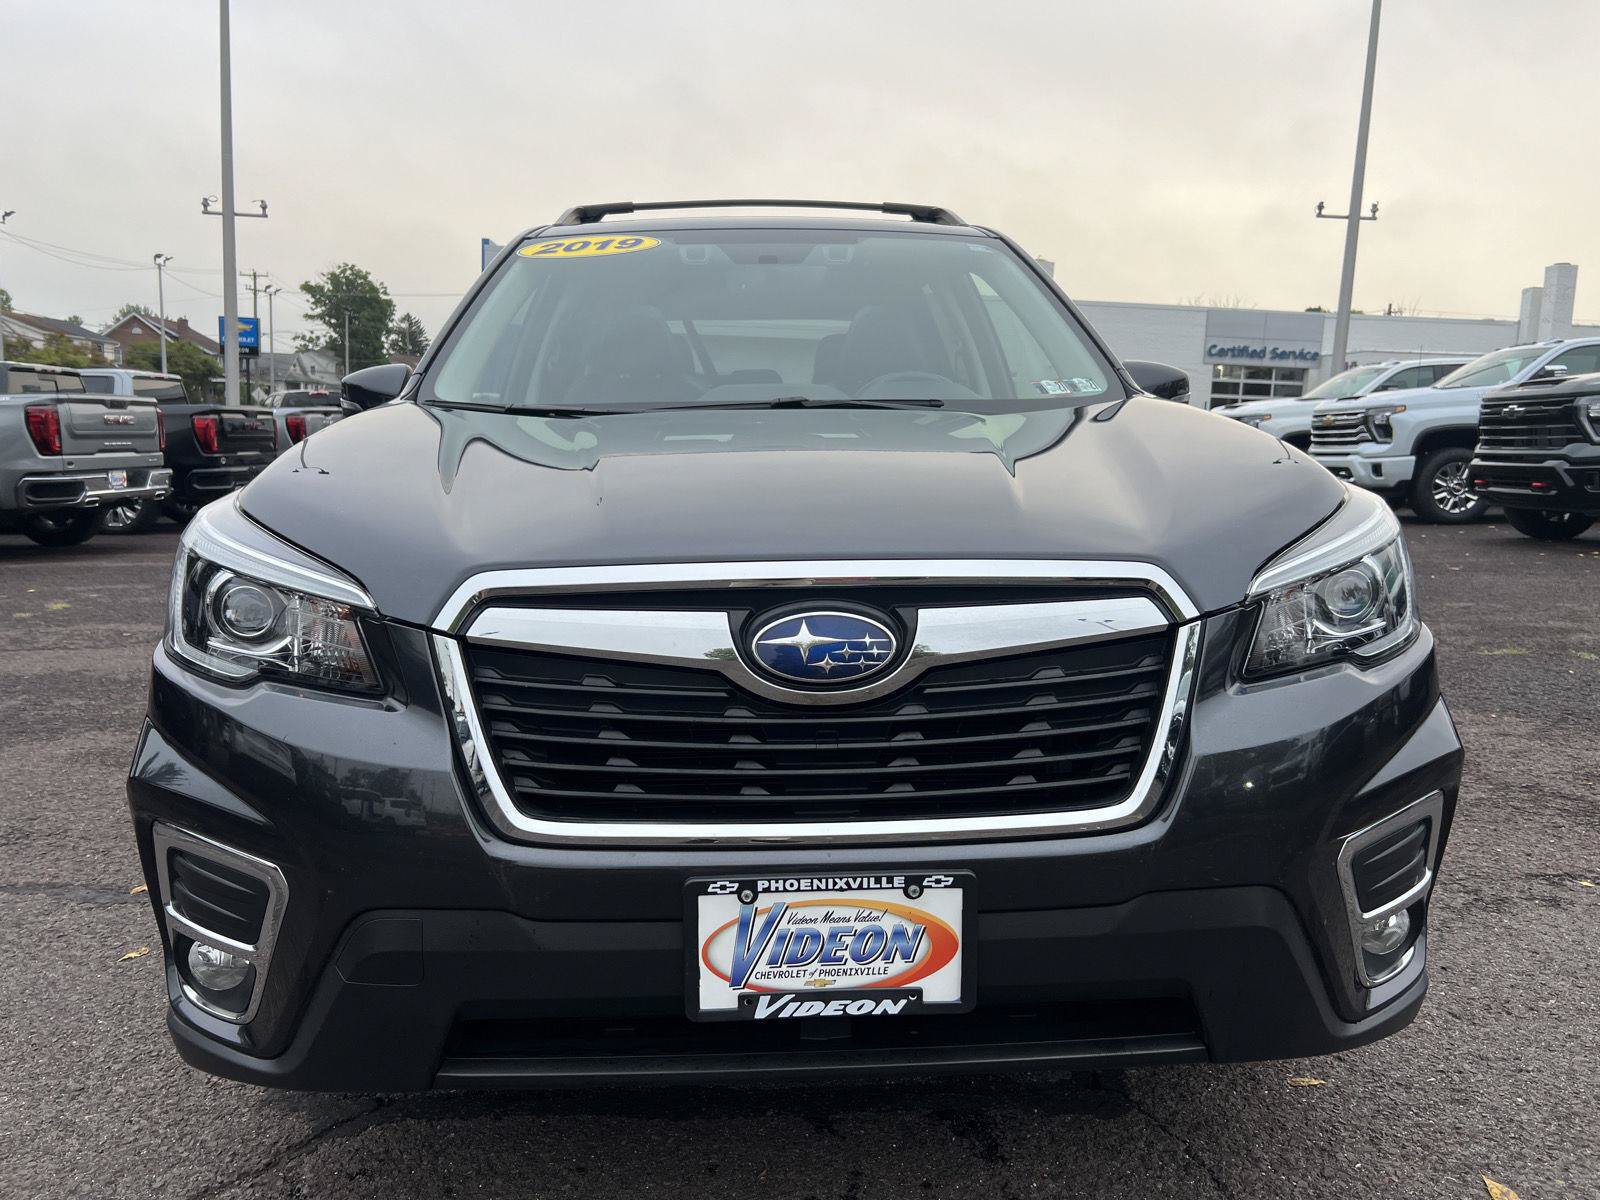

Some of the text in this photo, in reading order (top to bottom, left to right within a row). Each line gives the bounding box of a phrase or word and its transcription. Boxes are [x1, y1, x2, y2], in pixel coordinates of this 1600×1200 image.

[532, 238, 644, 255] 2019
[1207, 344, 1320, 361] Certified Service
[757, 876, 905, 892] PHOENIXVILLE
[787, 908, 888, 925] Videon Means Value!
[729, 902, 927, 990] VIDEON
[754, 966, 889, 980] CHEVROLET of PHOENIXVILLE
[754, 994, 907, 1020] VIDEON
